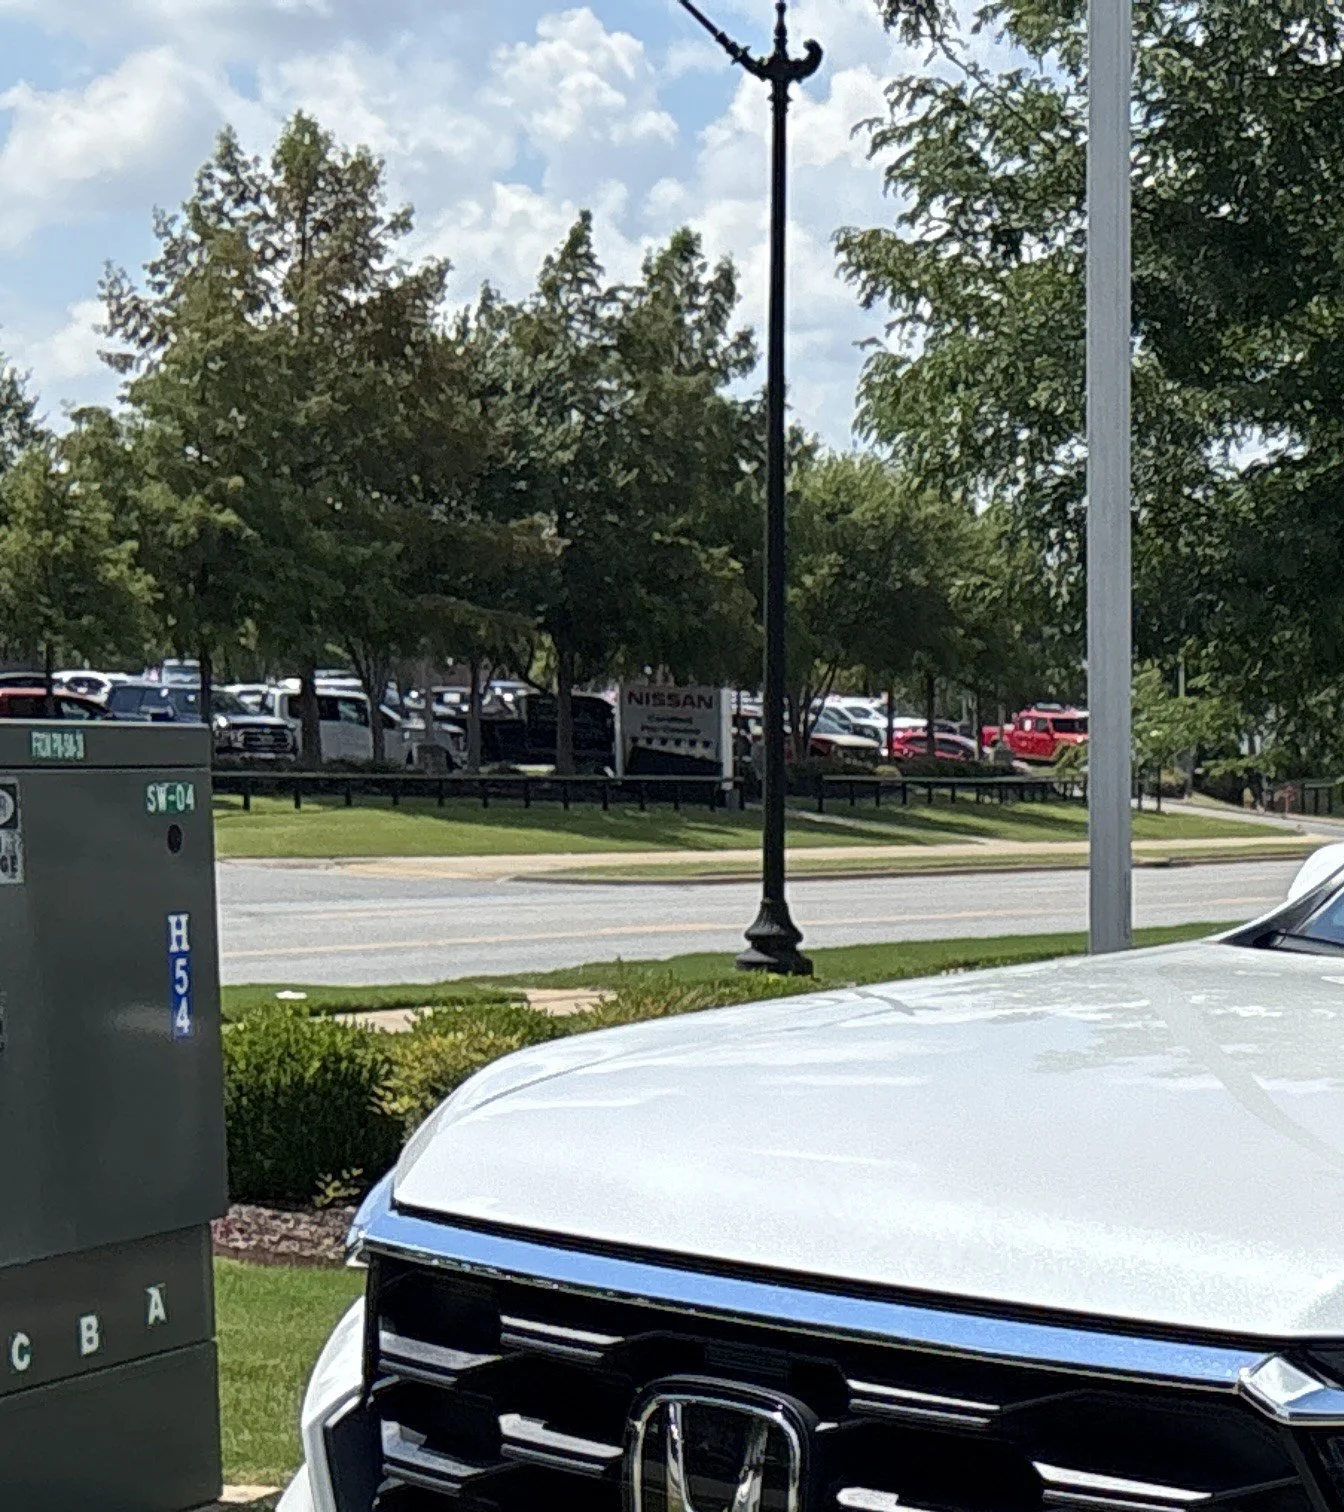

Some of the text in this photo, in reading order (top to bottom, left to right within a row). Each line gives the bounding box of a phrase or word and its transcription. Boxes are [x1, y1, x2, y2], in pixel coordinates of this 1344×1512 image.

[627, 690, 714, 710] NISSAN
[146, 782, 195, 813] SW-04
[11, 1283, 167, 1371] C B A
